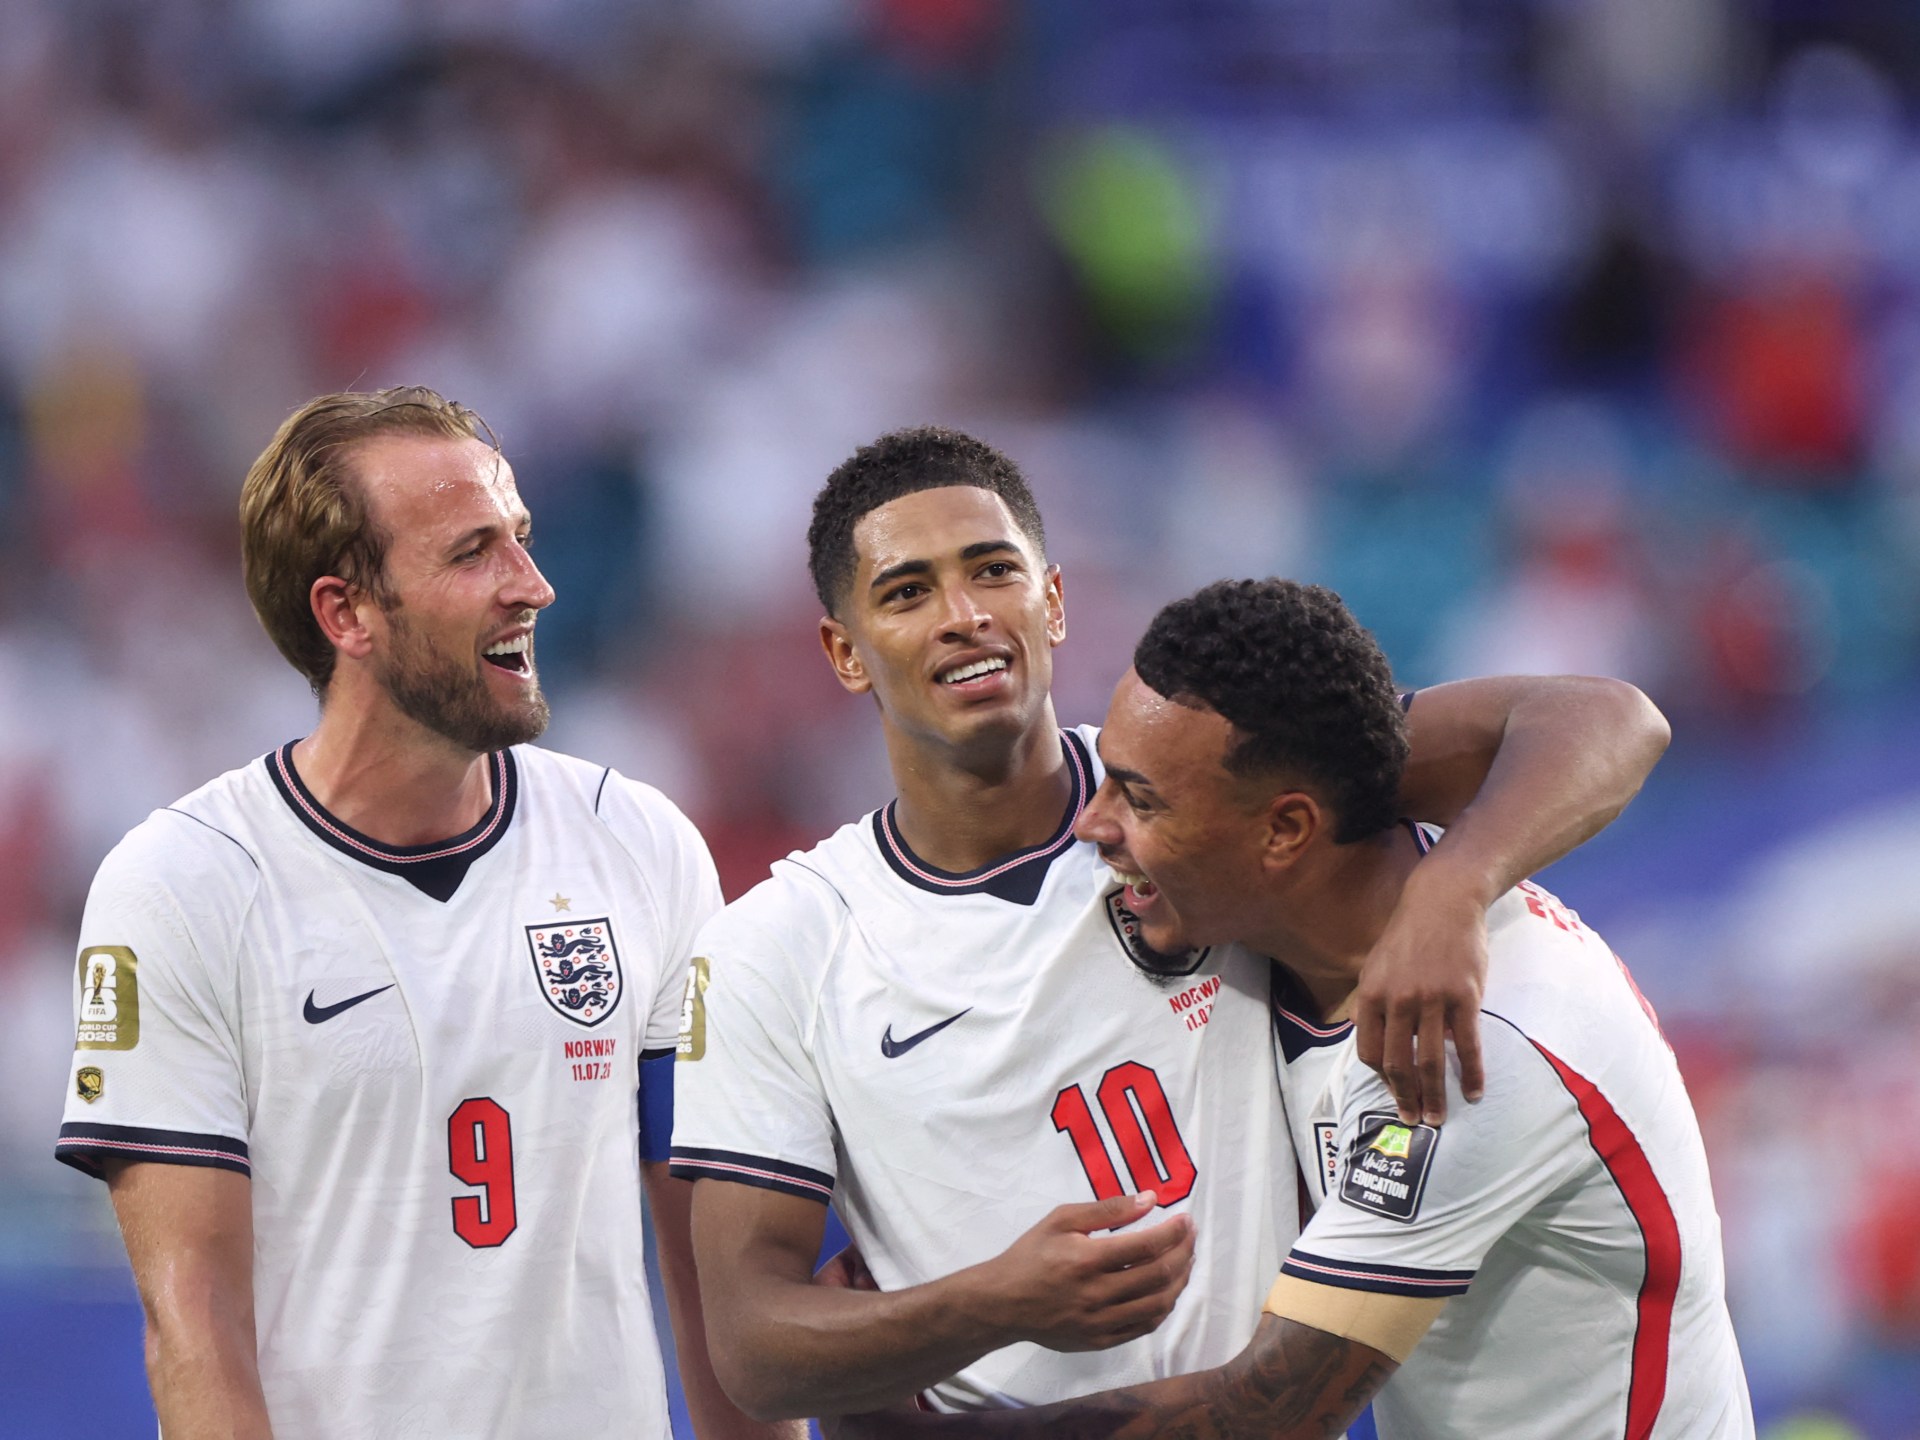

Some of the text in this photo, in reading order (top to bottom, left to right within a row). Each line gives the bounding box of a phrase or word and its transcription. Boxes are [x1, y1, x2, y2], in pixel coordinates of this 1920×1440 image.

[1169, 975, 1221, 1014] NORWA
[88, 1007, 106, 1015] FIFA
[77, 1031, 117, 1042] 2026
[79, 1023, 117, 1031] WORLD CUP
[564, 1038, 616, 1059] NORWAY
[1050, 1060, 1198, 1208] 10
[447, 1096, 518, 1249] 9
[1362, 1152, 1407, 1177] Unite For
[1351, 1168, 1410, 1200] EDUCATION
[1362, 1190, 1385, 1205] FIFA
